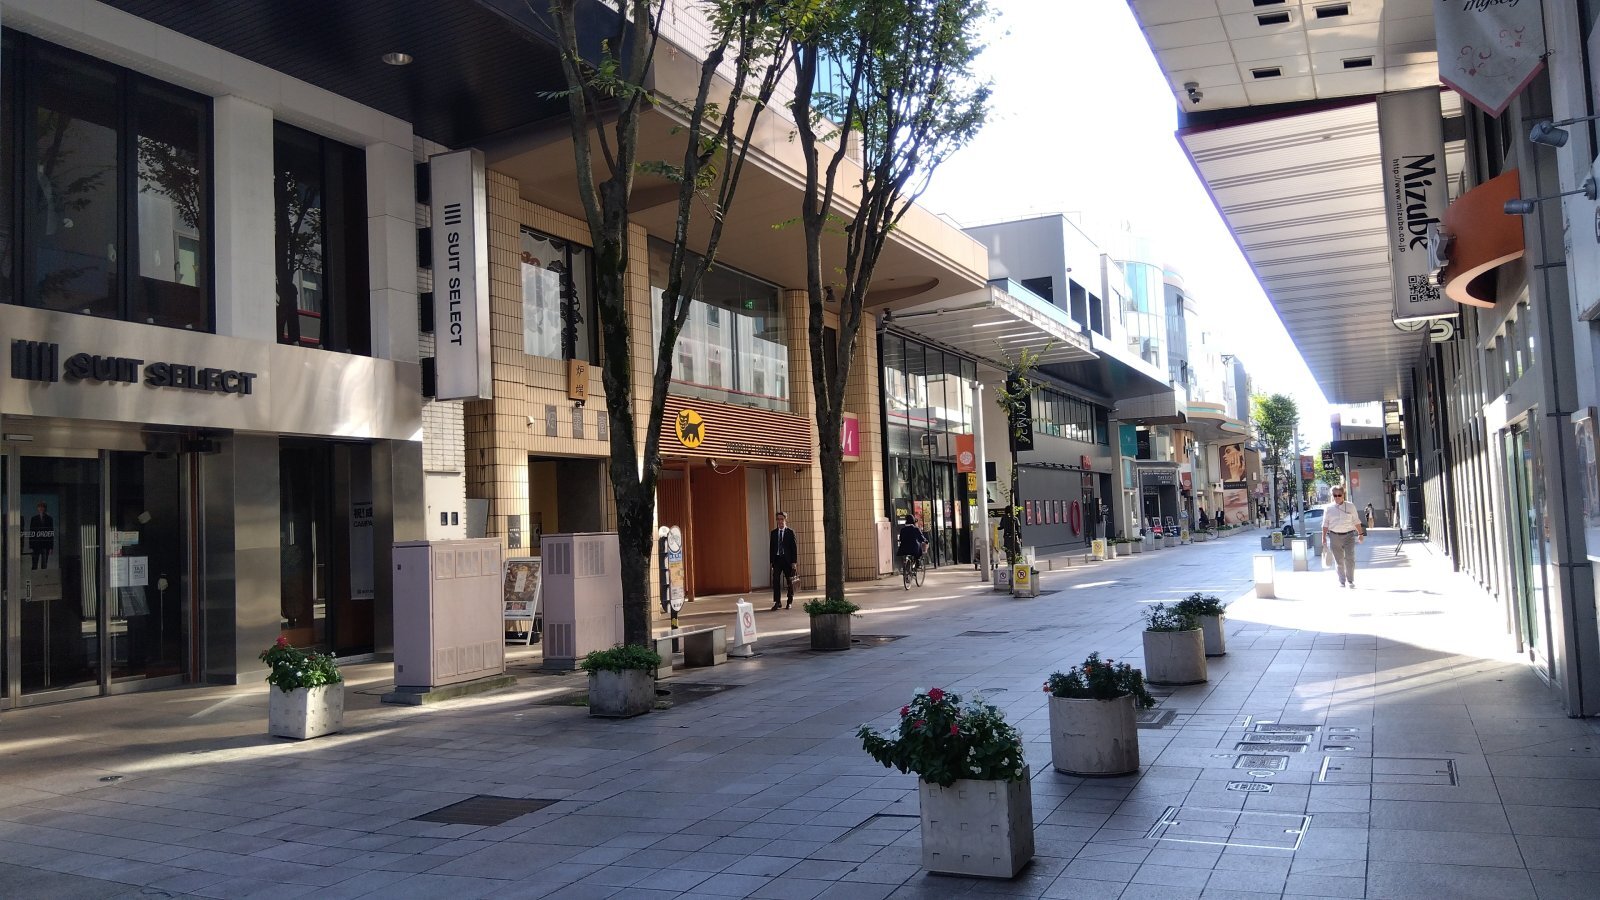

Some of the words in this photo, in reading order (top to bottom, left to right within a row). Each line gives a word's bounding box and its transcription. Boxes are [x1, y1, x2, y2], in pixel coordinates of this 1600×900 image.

[1392, 158, 1406, 253] http://www.mizube.co.jp
[1402, 153, 1441, 252] Mizube
[448, 231, 461, 272] SUIT
[449, 277, 463, 346] SELECT
[65, 352, 144, 384] SUIT
[145, 363, 258, 395] SELECT
[36, 530, 55, 538] ORDER
